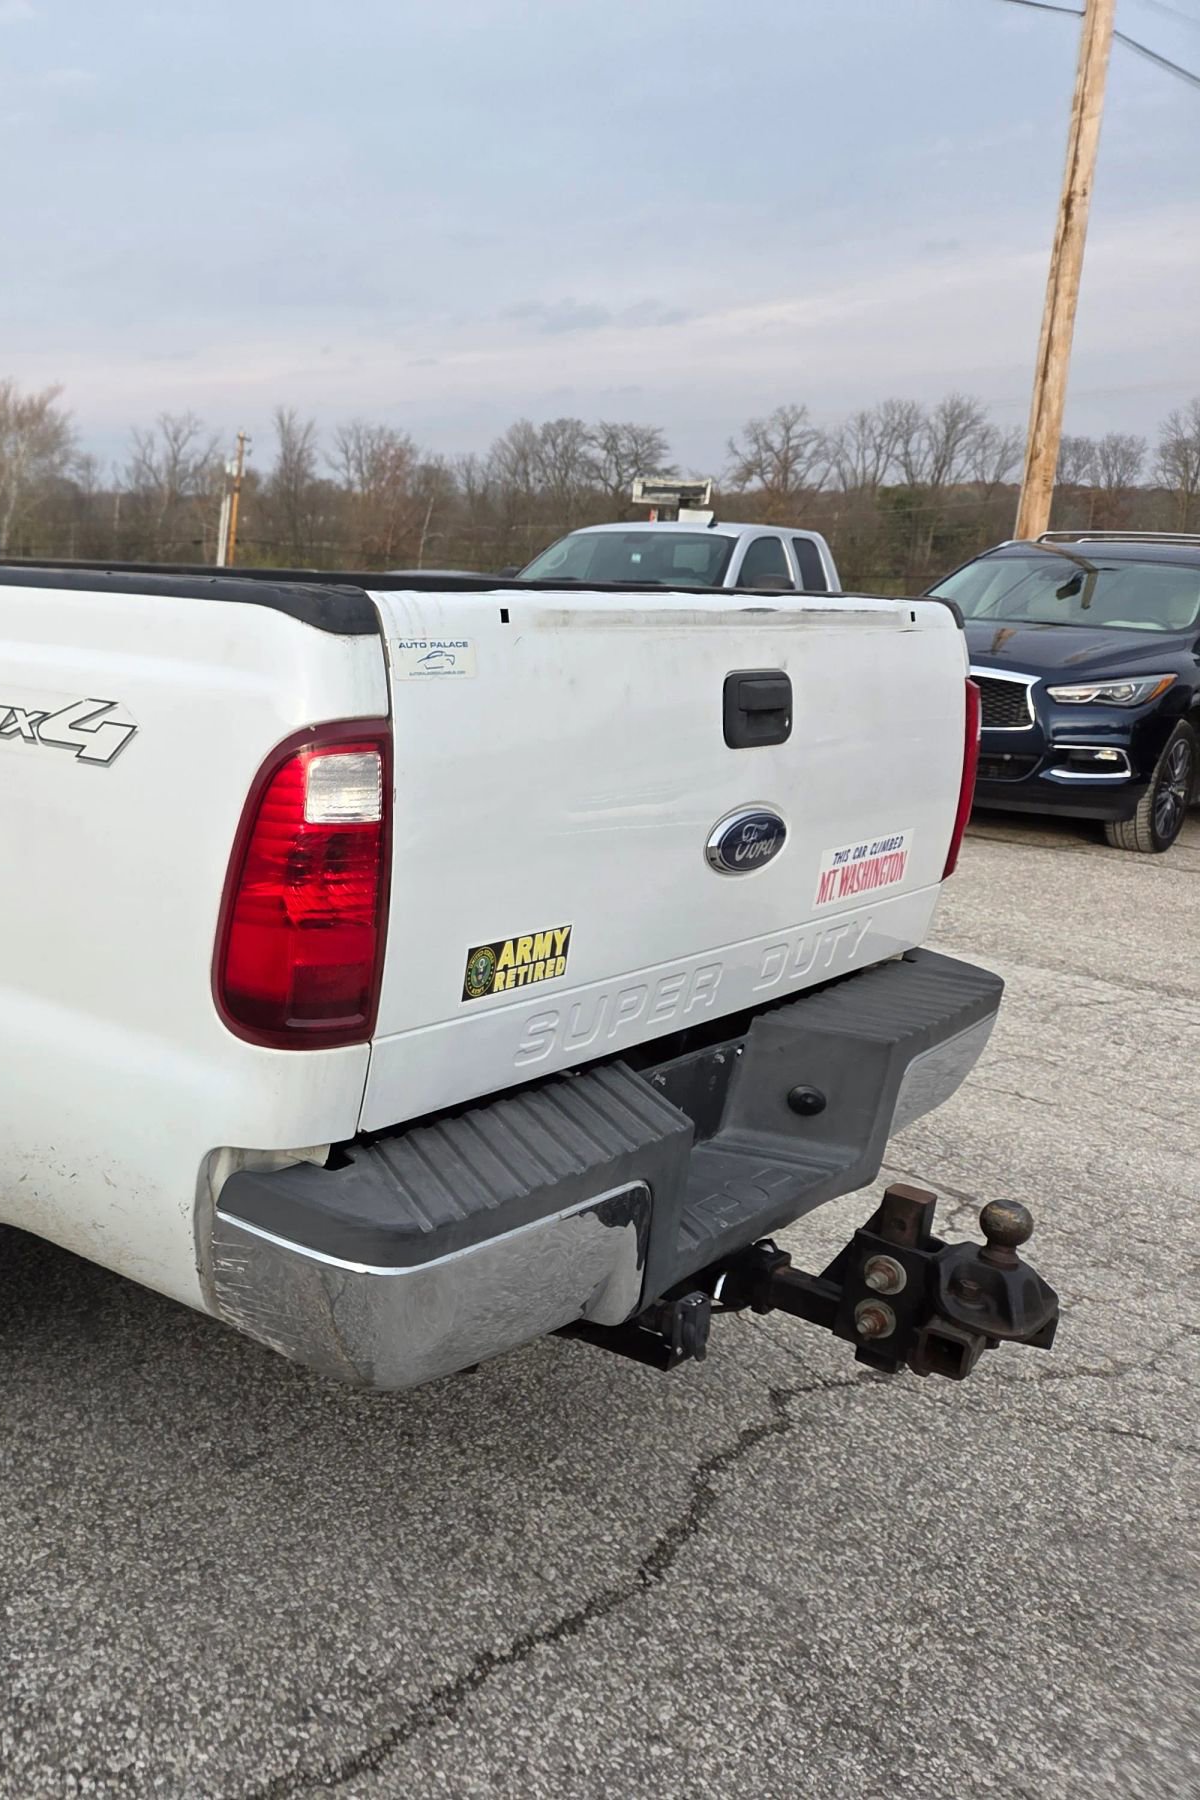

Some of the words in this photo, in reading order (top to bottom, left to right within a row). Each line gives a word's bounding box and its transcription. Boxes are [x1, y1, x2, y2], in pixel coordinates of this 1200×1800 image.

[735, 822, 778, 862] Ford
[832, 849, 851, 866] THIS
[852, 845, 868, 860] CAR
[869, 835, 904, 856] CLIMBED
[838, 850, 908, 898] WASHINGTON
[496, 927, 570, 970] ARMY
[493, 956, 566, 992] RETIRED
[514, 962, 724, 1067] SUPER
[752, 917, 873, 992] DUTY
